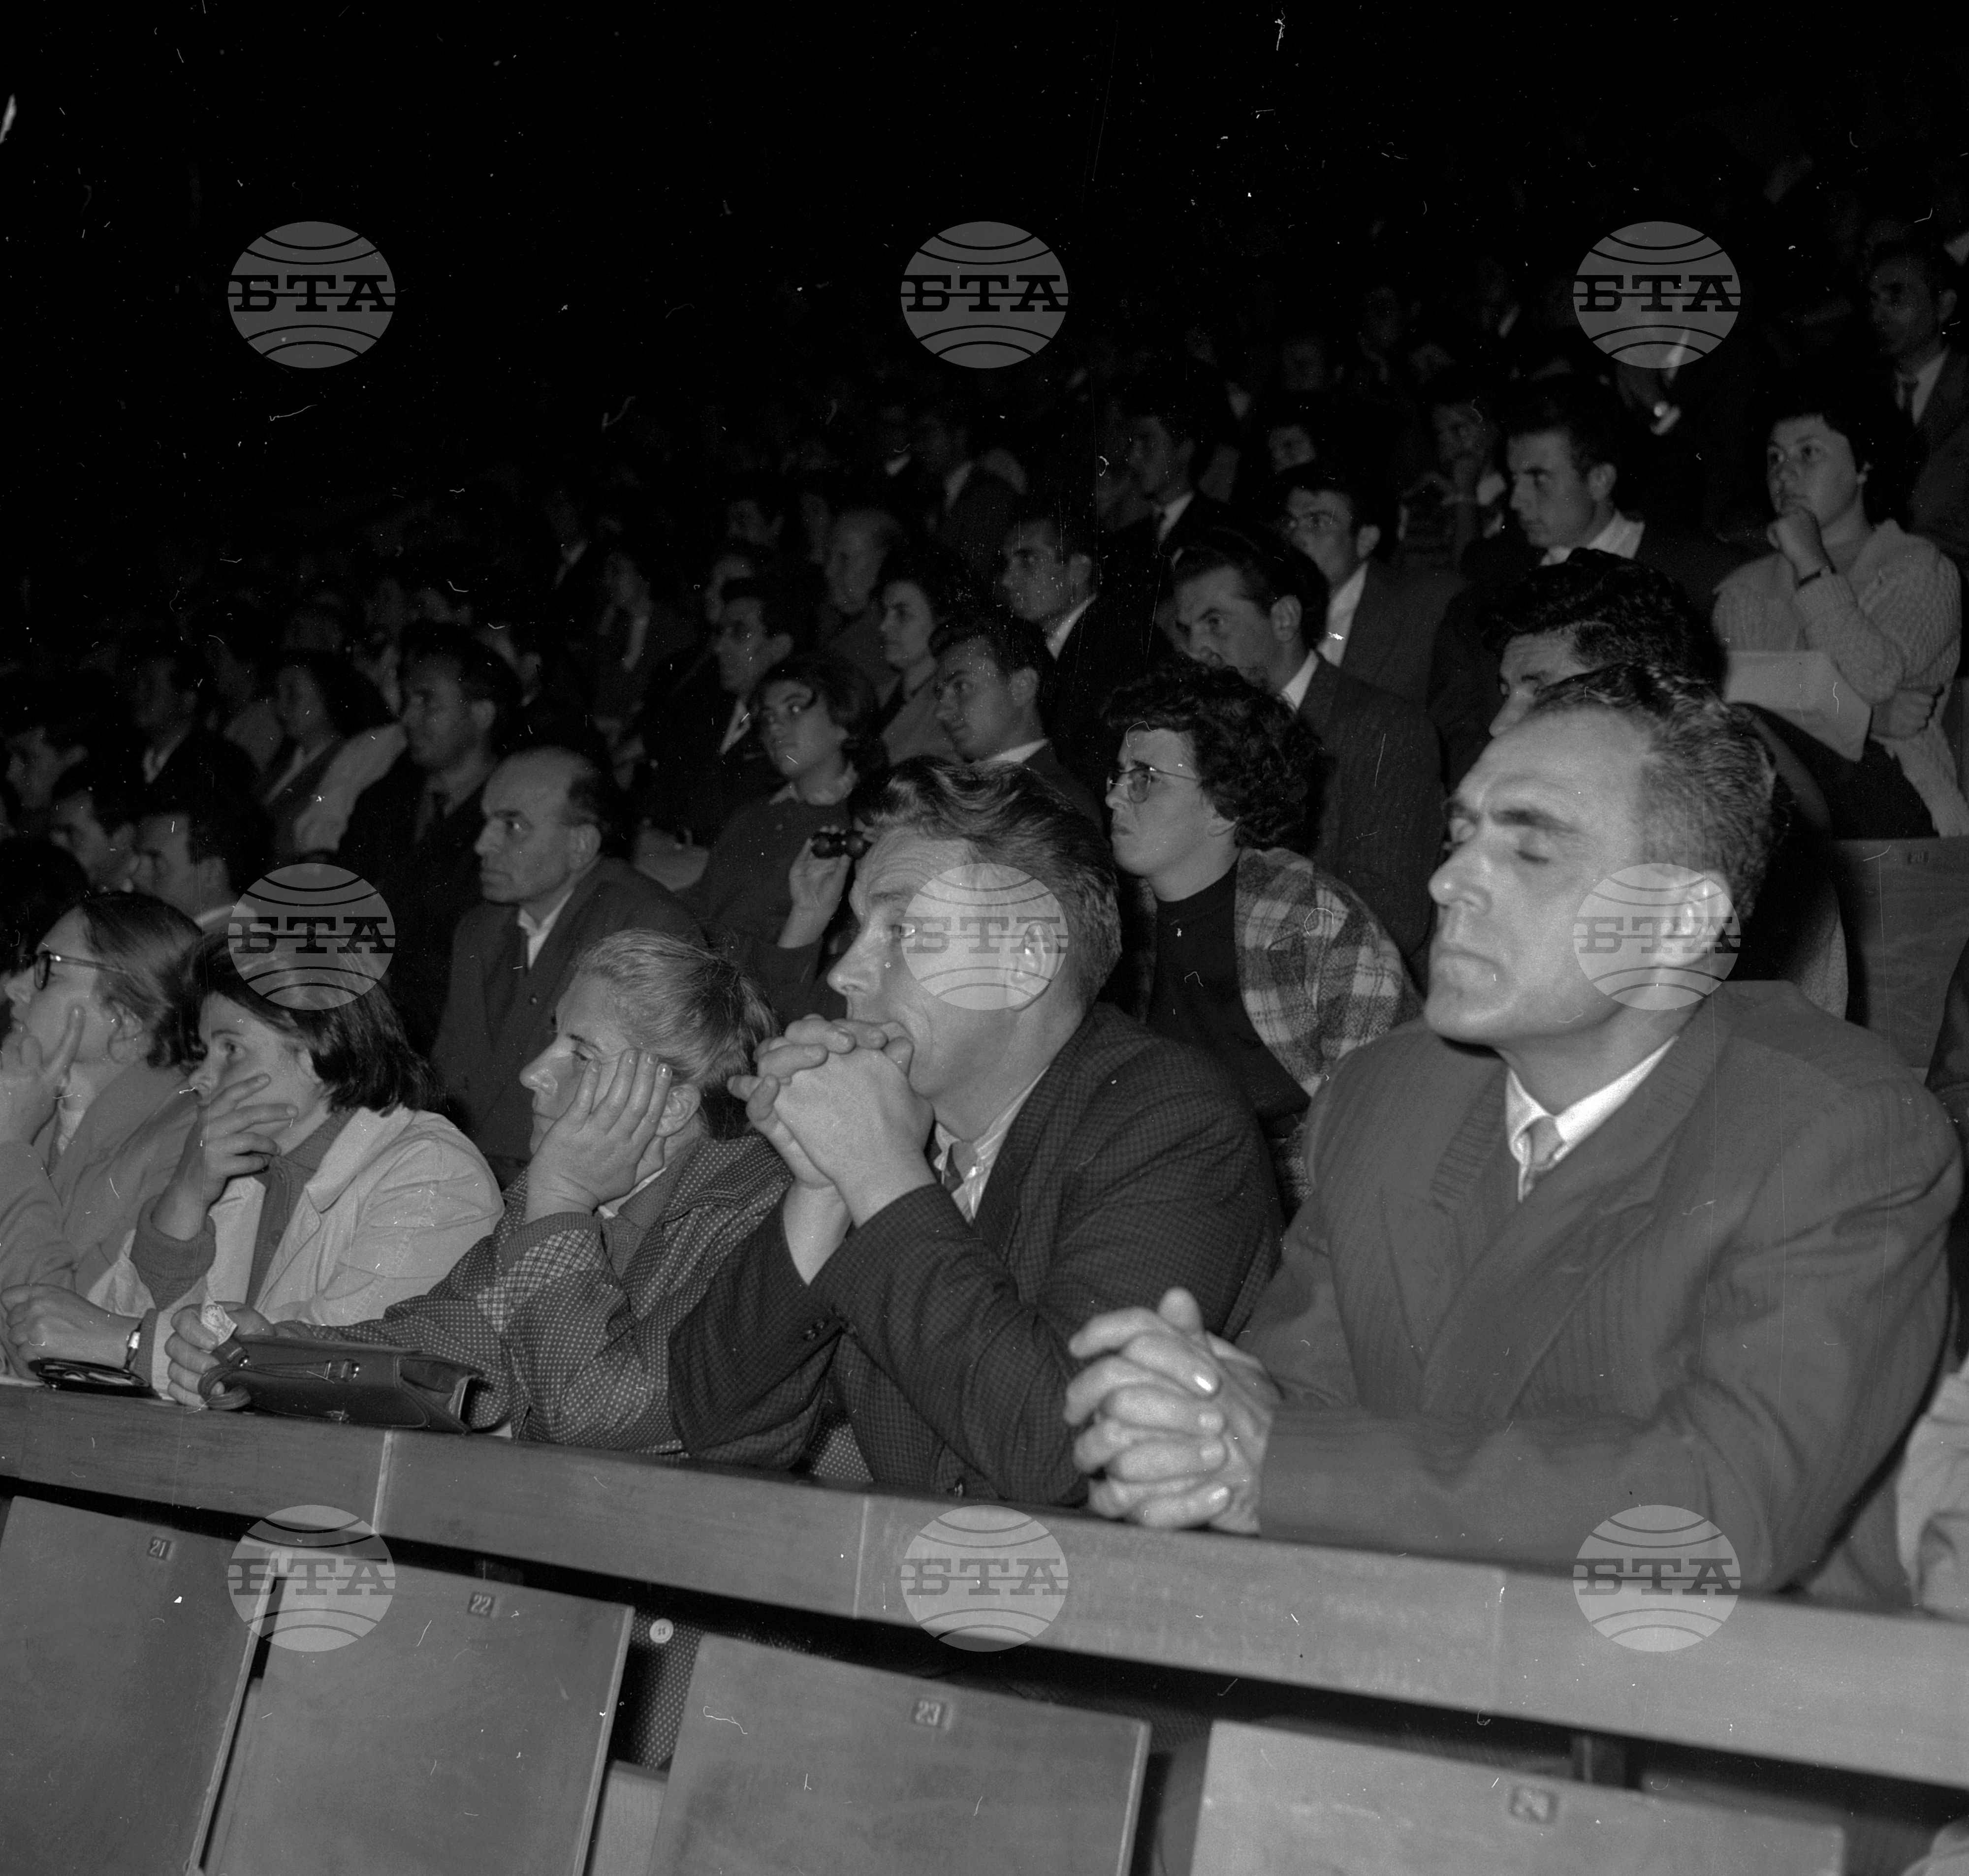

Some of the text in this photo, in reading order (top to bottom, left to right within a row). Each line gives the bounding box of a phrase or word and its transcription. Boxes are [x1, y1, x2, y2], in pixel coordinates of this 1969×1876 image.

[149, 1539, 167, 1557] 21
[470, 1594, 492, 1615] 22
[915, 1699, 941, 1726] 23
